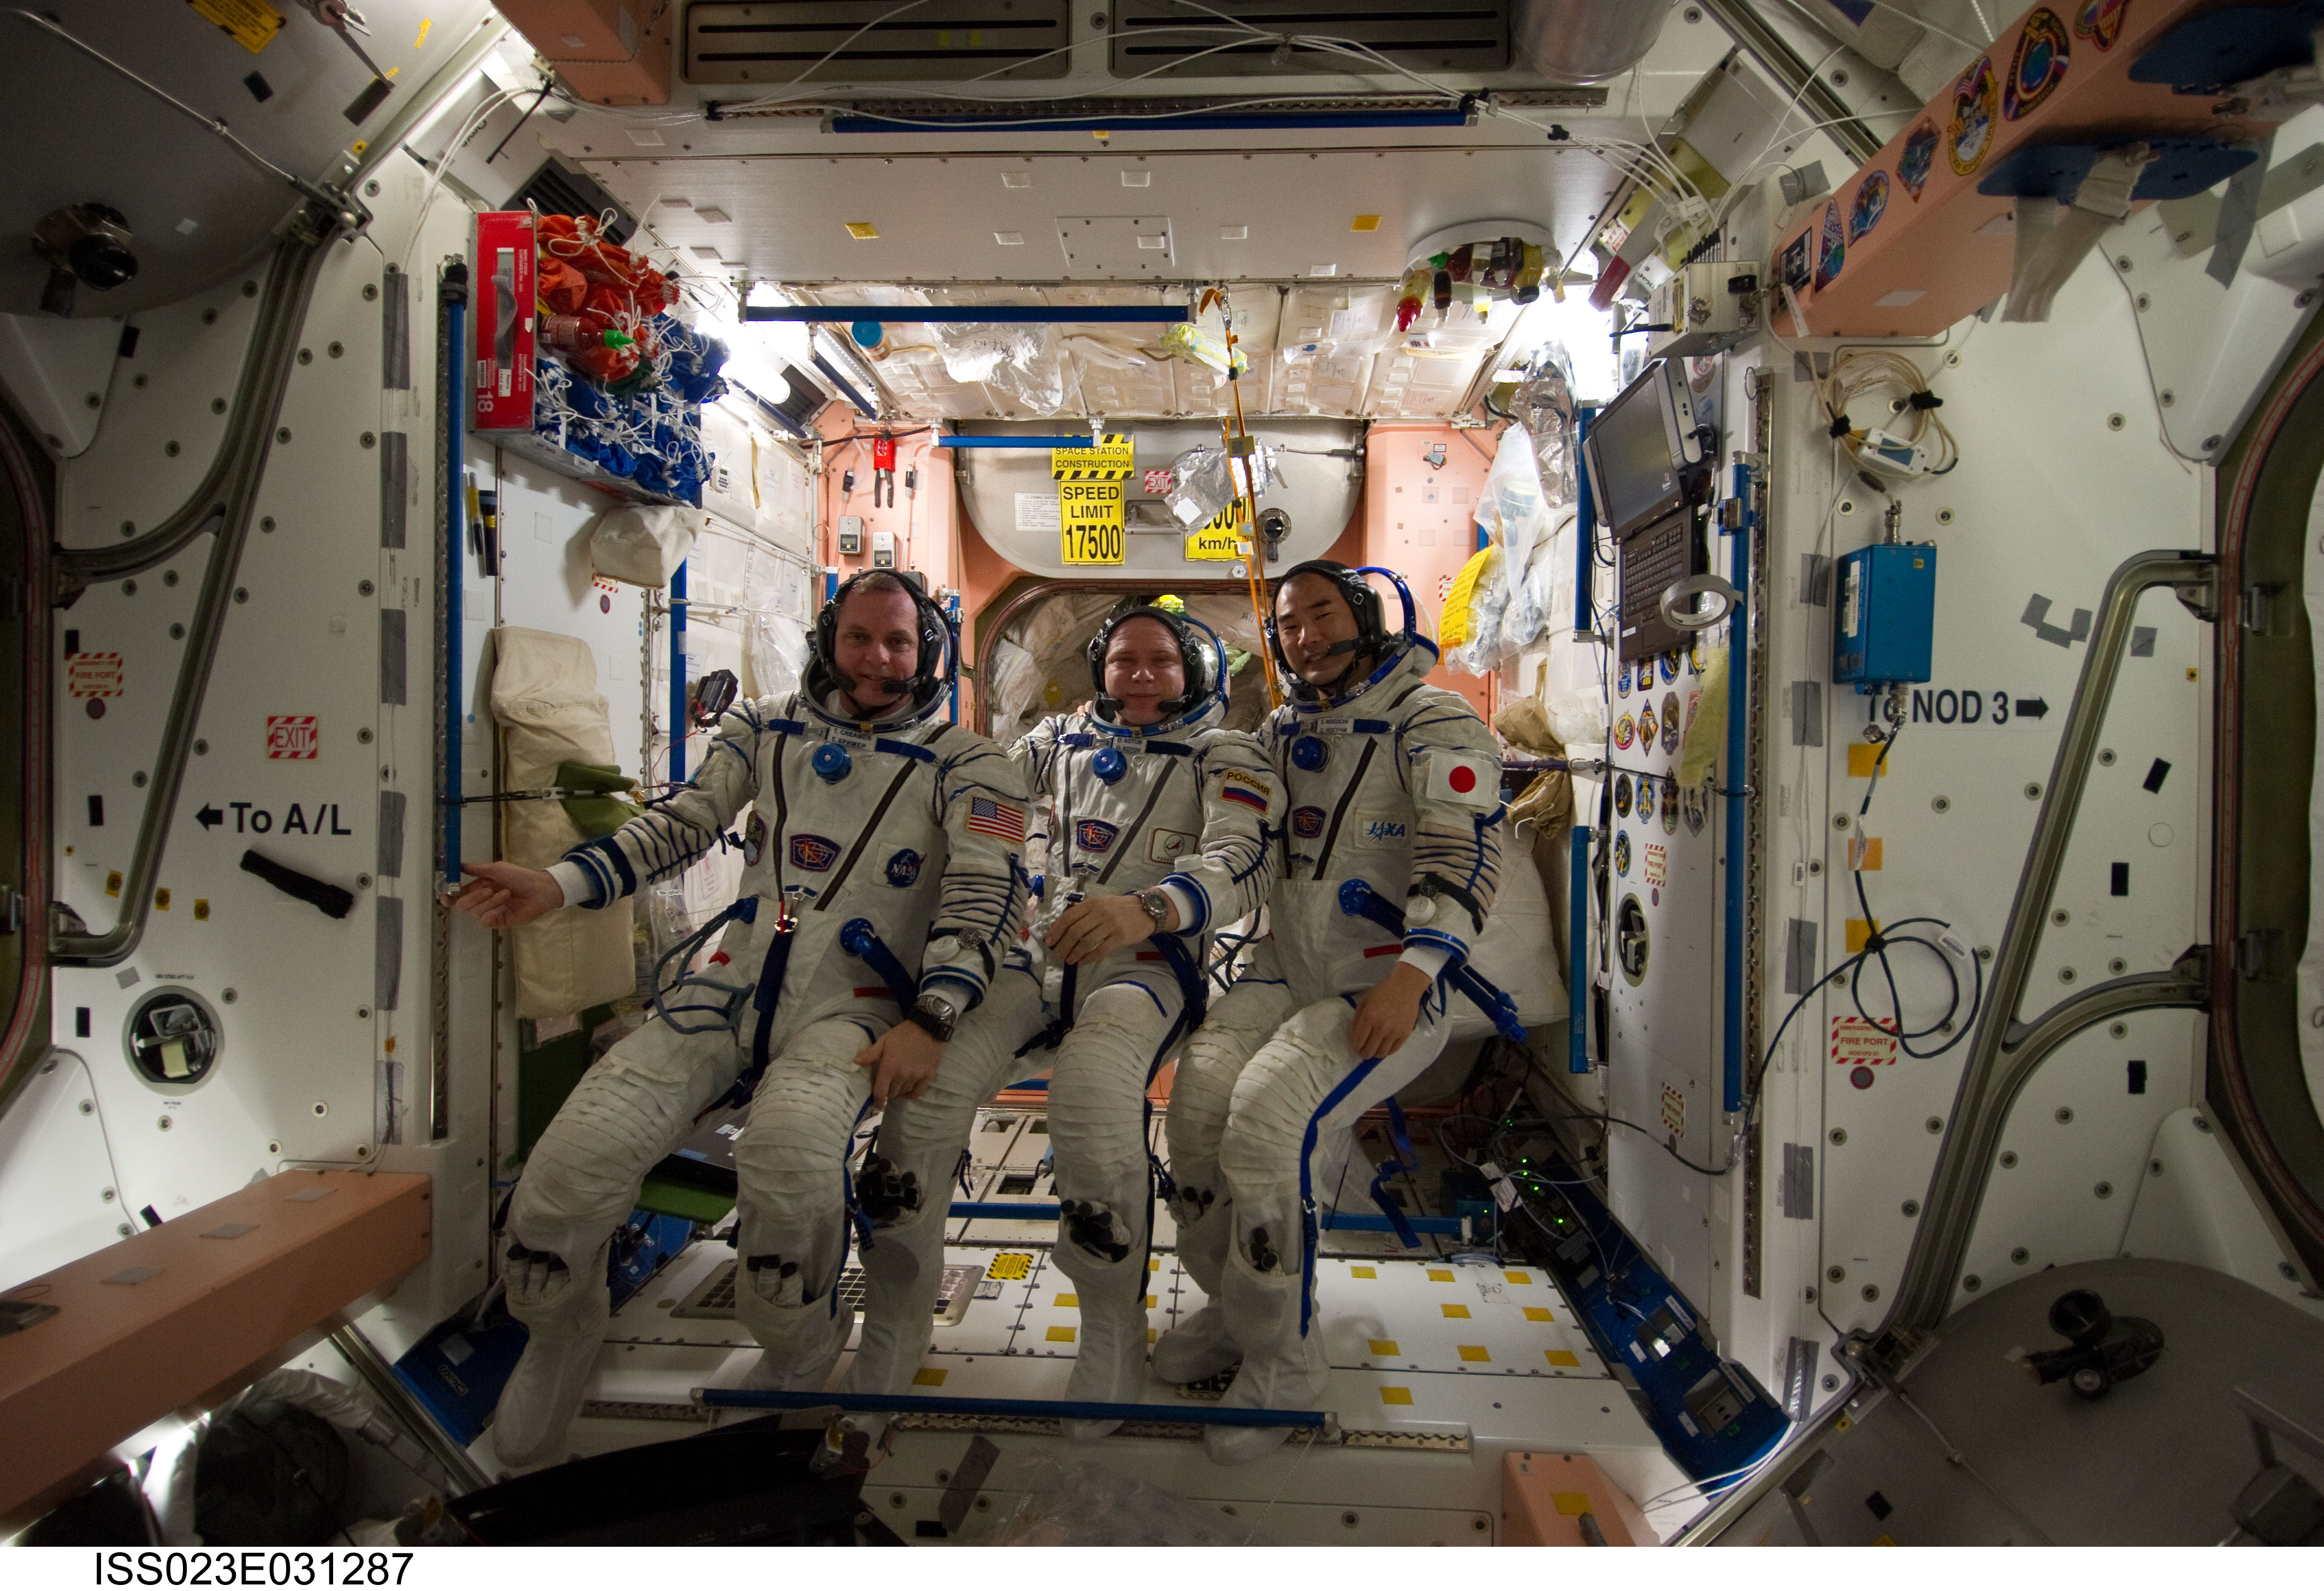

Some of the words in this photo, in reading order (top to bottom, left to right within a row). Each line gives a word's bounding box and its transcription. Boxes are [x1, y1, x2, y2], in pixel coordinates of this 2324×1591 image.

[477, 391, 494, 412] 18
[1056, 447, 1087, 455] SPACE
[1089, 447, 1129, 455] STATION
[1056, 460, 1129, 468] CONSTRUCTION
[1148, 476, 1168, 488] EXIT
[1063, 486, 1119, 500] SPEED
[1071, 505, 1113, 518] LIMIT
[1066, 524, 1120, 559] 17500
[1199, 536, 1237, 550] km/h
[1913, 689, 1982, 724] NOD
[1992, 690, 2009, 725] 3
[274, 726, 310, 748] EXIT
[840, 729, 872, 741] CREAMER
[1226, 771, 1270, 796] РОССИЯ
[229, 802, 272, 834] To
[282, 803, 352, 836] A/L
[1365, 820, 1406, 842] JAXA
